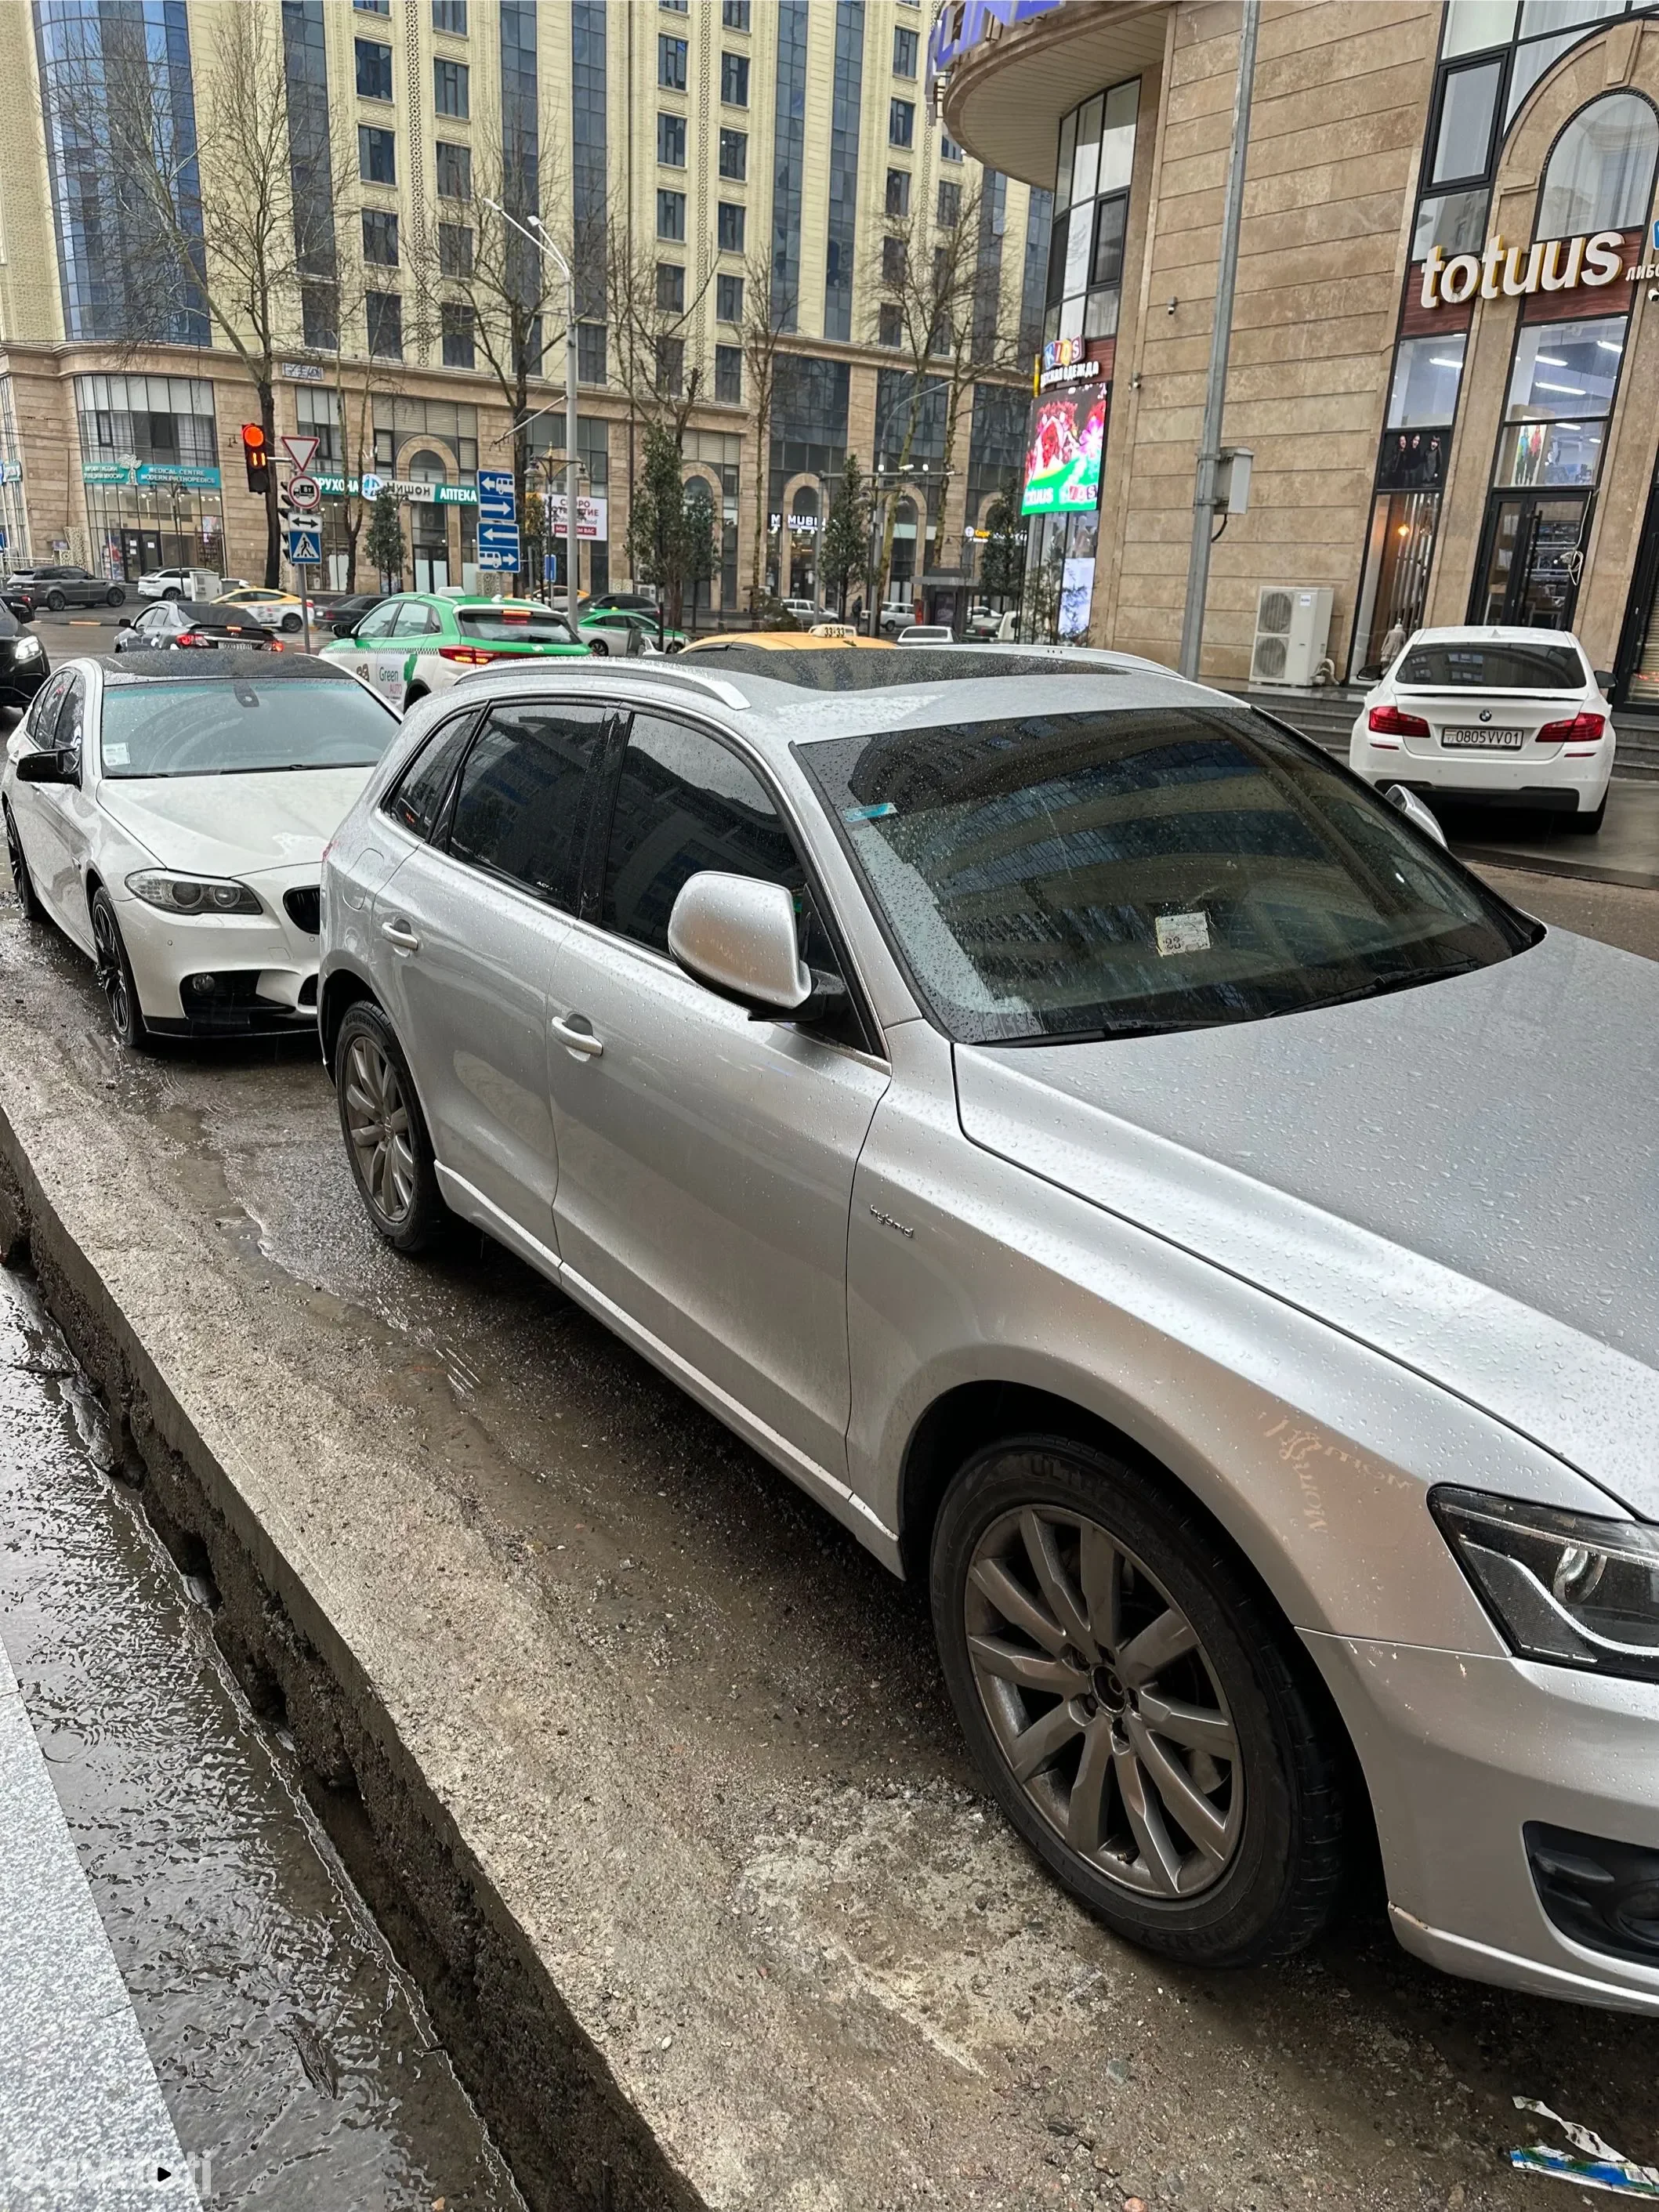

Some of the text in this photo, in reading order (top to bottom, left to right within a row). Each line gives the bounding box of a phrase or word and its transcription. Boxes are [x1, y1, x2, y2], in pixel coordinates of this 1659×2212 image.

[1421, 231, 1626, 309] totuus
[1045, 335, 1082, 370] KIDS
[440, 487, 477, 502] АПТЕКА
[379, 667, 398, 682] Green
